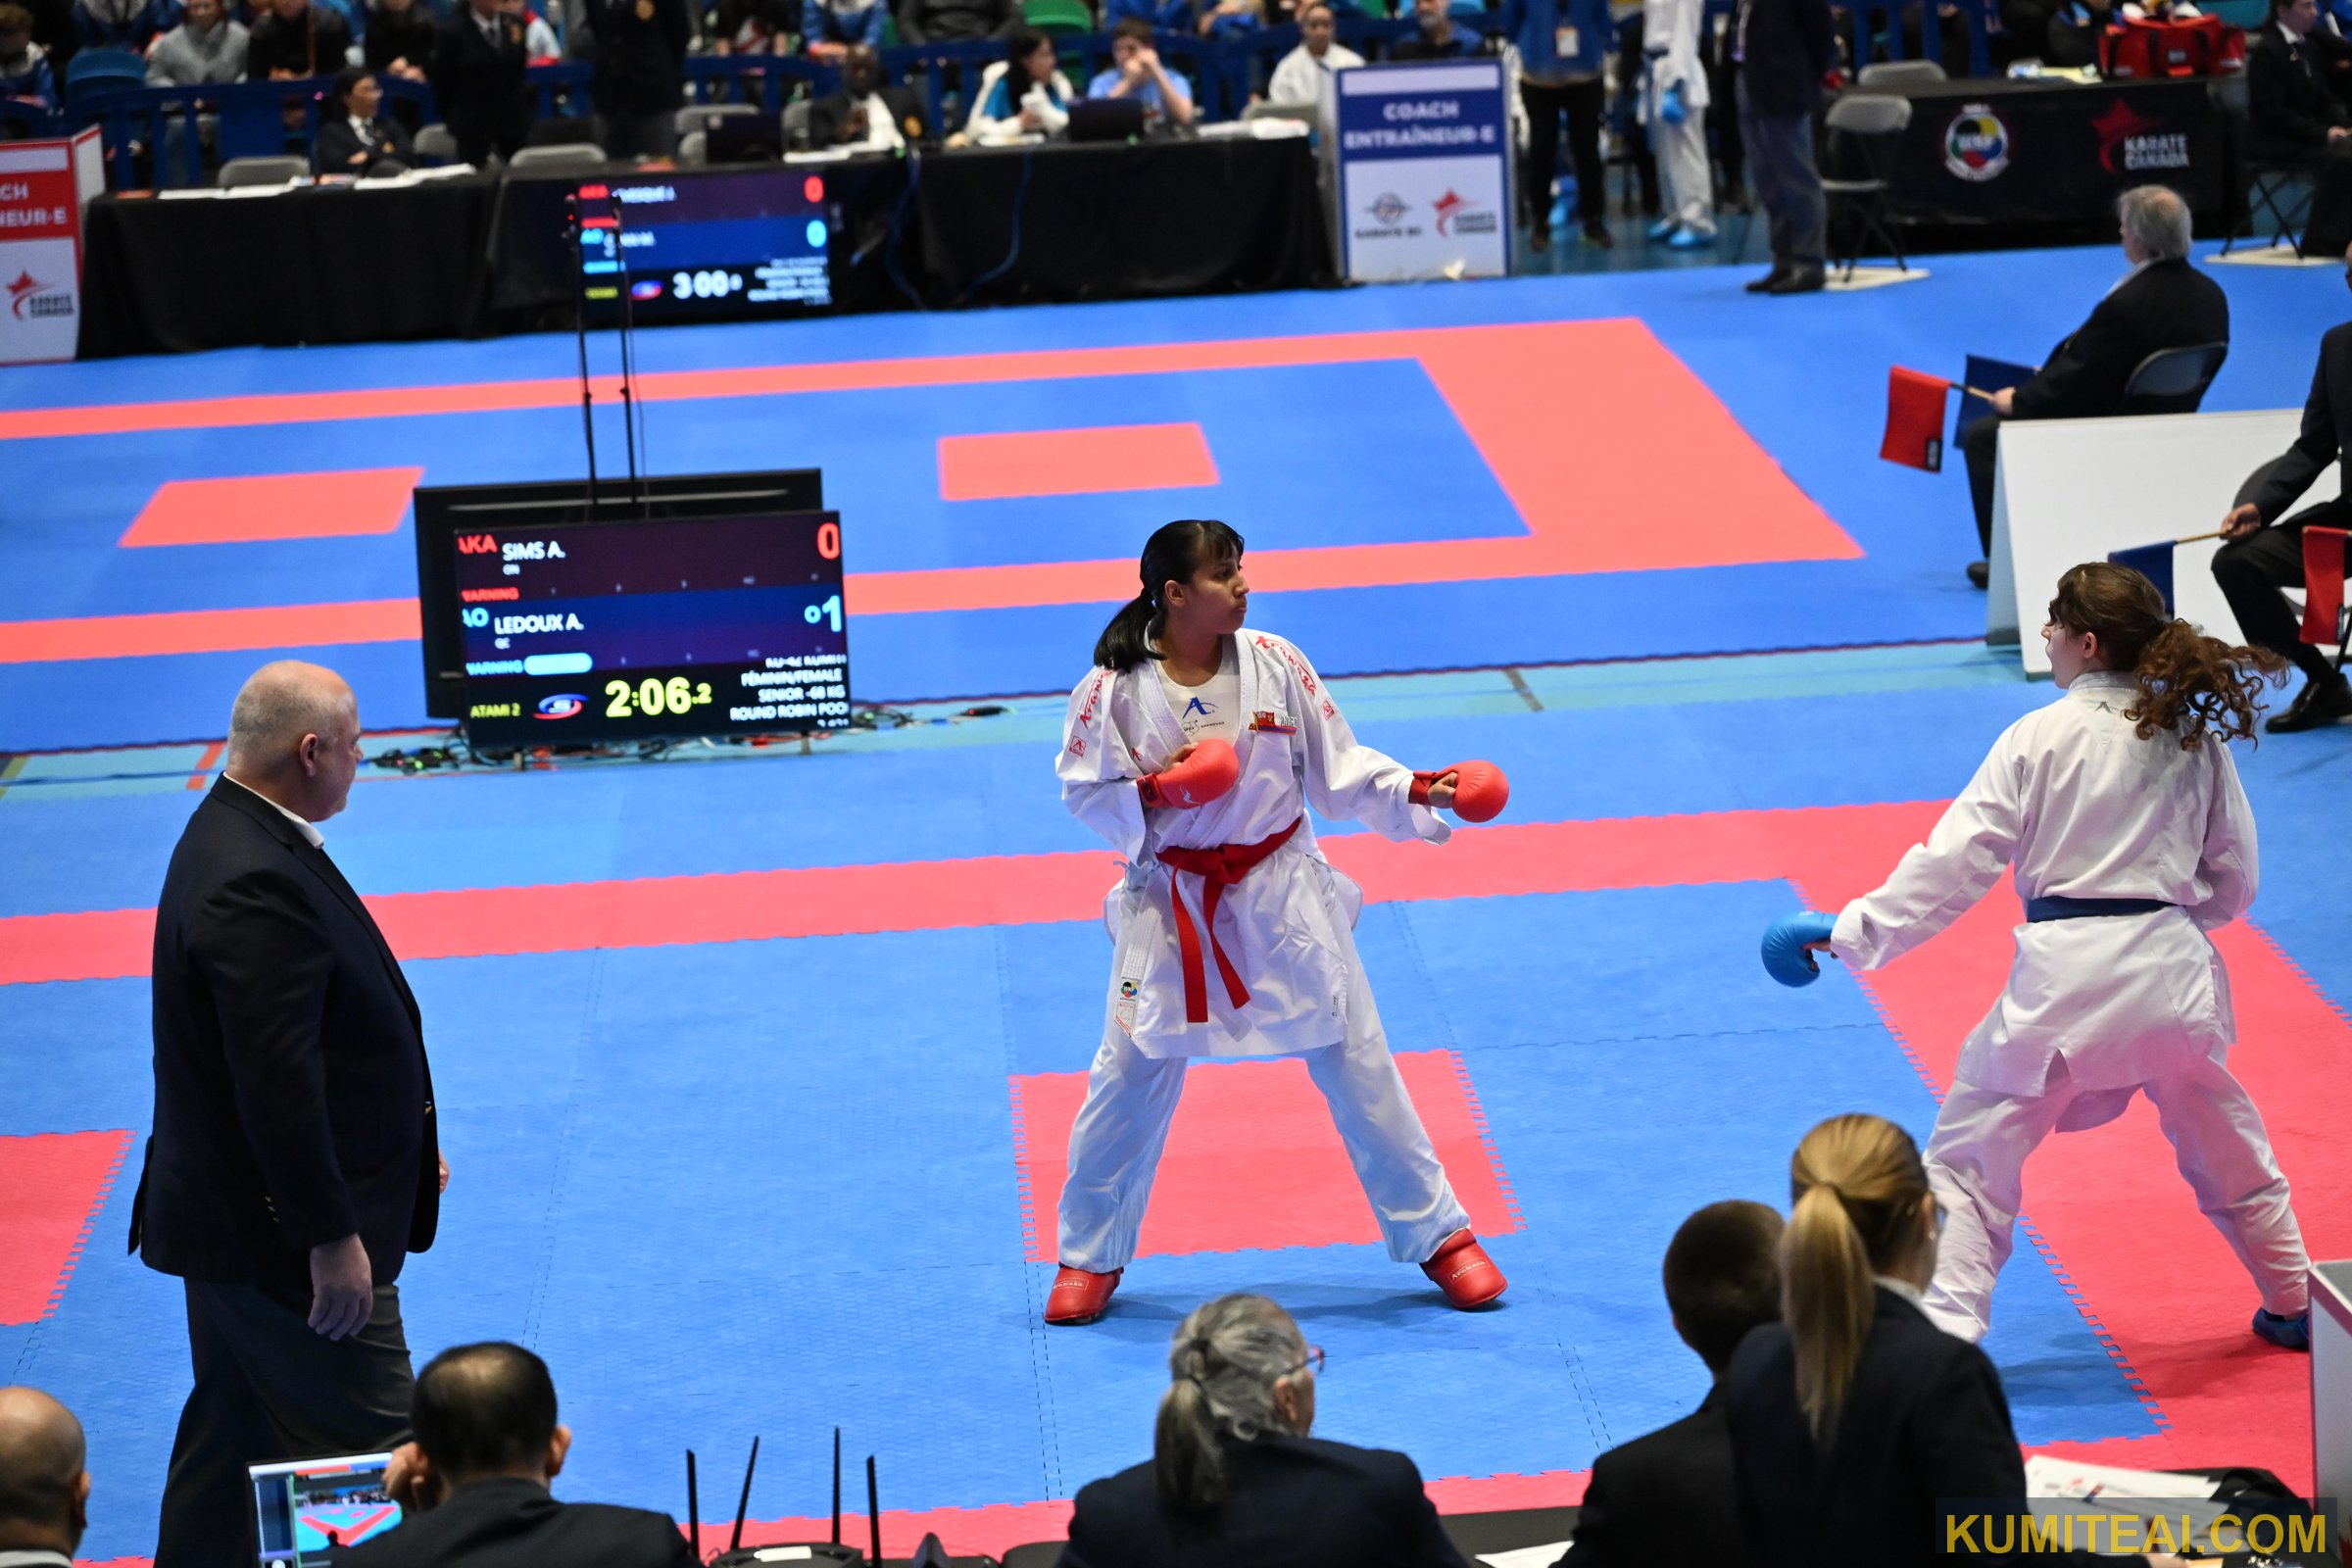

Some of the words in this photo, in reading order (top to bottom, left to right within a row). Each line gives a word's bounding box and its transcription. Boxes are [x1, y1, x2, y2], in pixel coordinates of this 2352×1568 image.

[1383, 101, 1460, 121] COACH
[2125, 134, 2187, 151] KARATE
[804, 176, 824, 203] 0
[806, 220, 827, 248] 0
[502, 541, 546, 562] SIMS
[547, 540, 566, 559] A.
[816, 522, 841, 560] 0
[494, 613, 564, 635] LEDOUX
[565, 612, 585, 630] A.
[512, 702, 521, 717] 2
[605, 676, 713, 717] 2:06.2
[758, 686, 805, 703] SENIOR
[827, 684, 846, 699] KG
[729, 705, 777, 721] ROUND
[777, 702, 817, 719] ROBIN
[818, 700, 849, 716] POO
